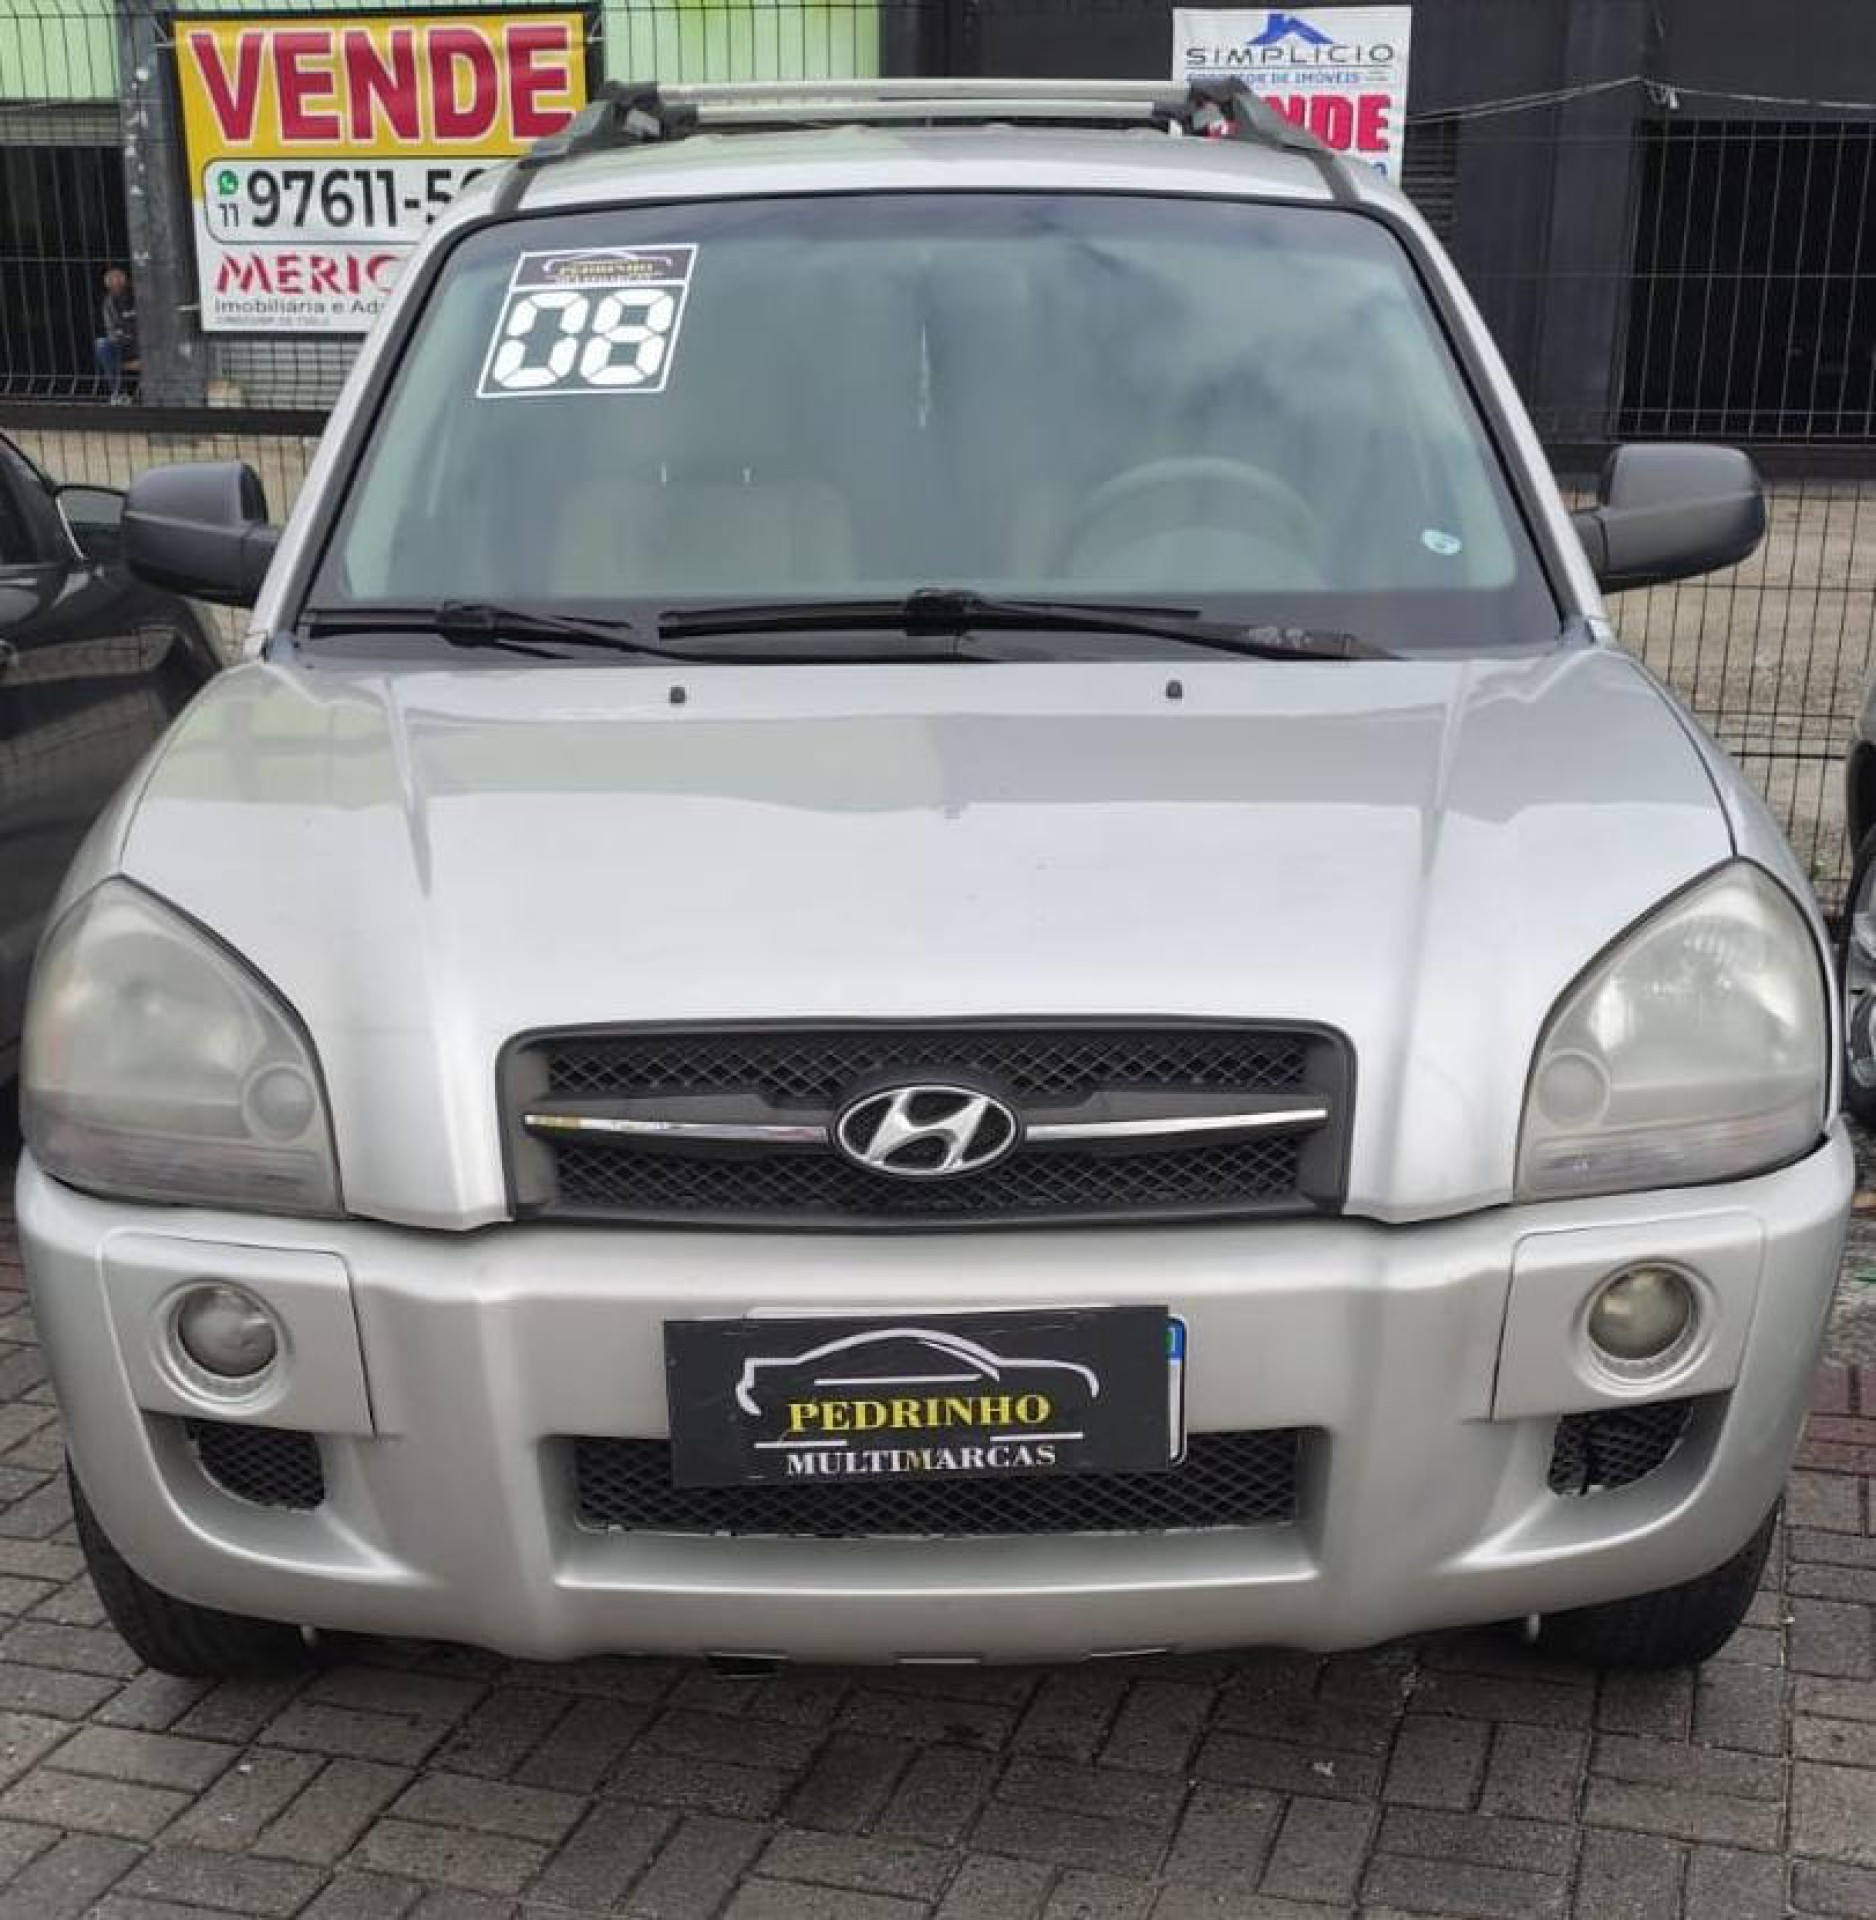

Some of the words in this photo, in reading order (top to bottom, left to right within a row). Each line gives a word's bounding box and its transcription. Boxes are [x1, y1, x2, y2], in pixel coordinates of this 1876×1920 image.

[1186, 44, 1395, 65] SIMPLICIO
[189, 25, 576, 144] VENDE
[217, 203, 240, 228] 11
[247, 168, 487, 228] 97611-5
[493, 289, 674, 388] 08
[787, 1394, 1052, 1432] PEDRINHO
[786, 1444, 1056, 1476] MULTIMARCAS
